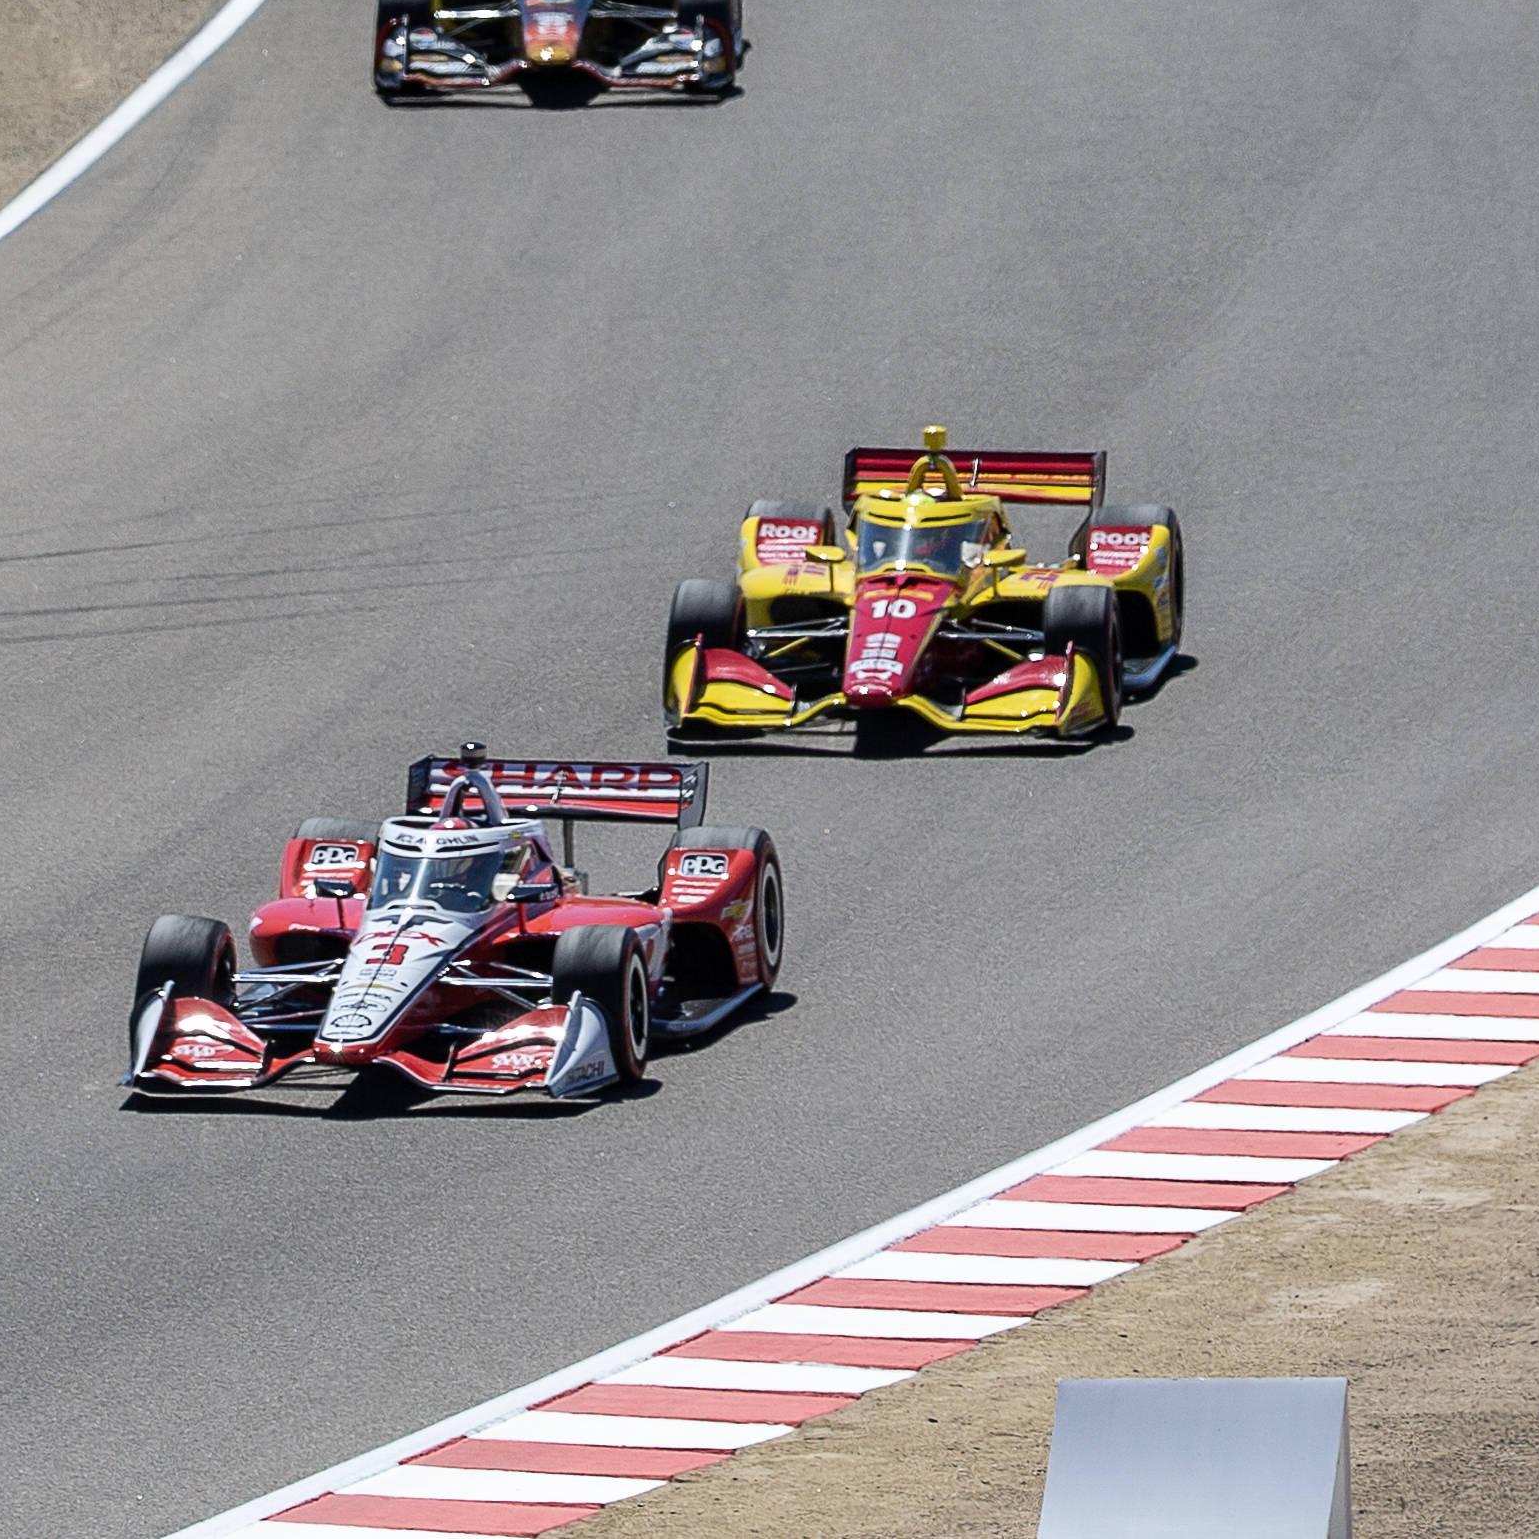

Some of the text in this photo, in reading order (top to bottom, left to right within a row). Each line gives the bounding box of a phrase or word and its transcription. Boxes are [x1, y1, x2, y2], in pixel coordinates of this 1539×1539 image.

[871, 599, 917, 619] 10
[442, 762, 683, 791] SHARP
[312, 846, 357, 865] PPG
[682, 856, 726, 875] PPG
[365, 944, 409, 966] 3
